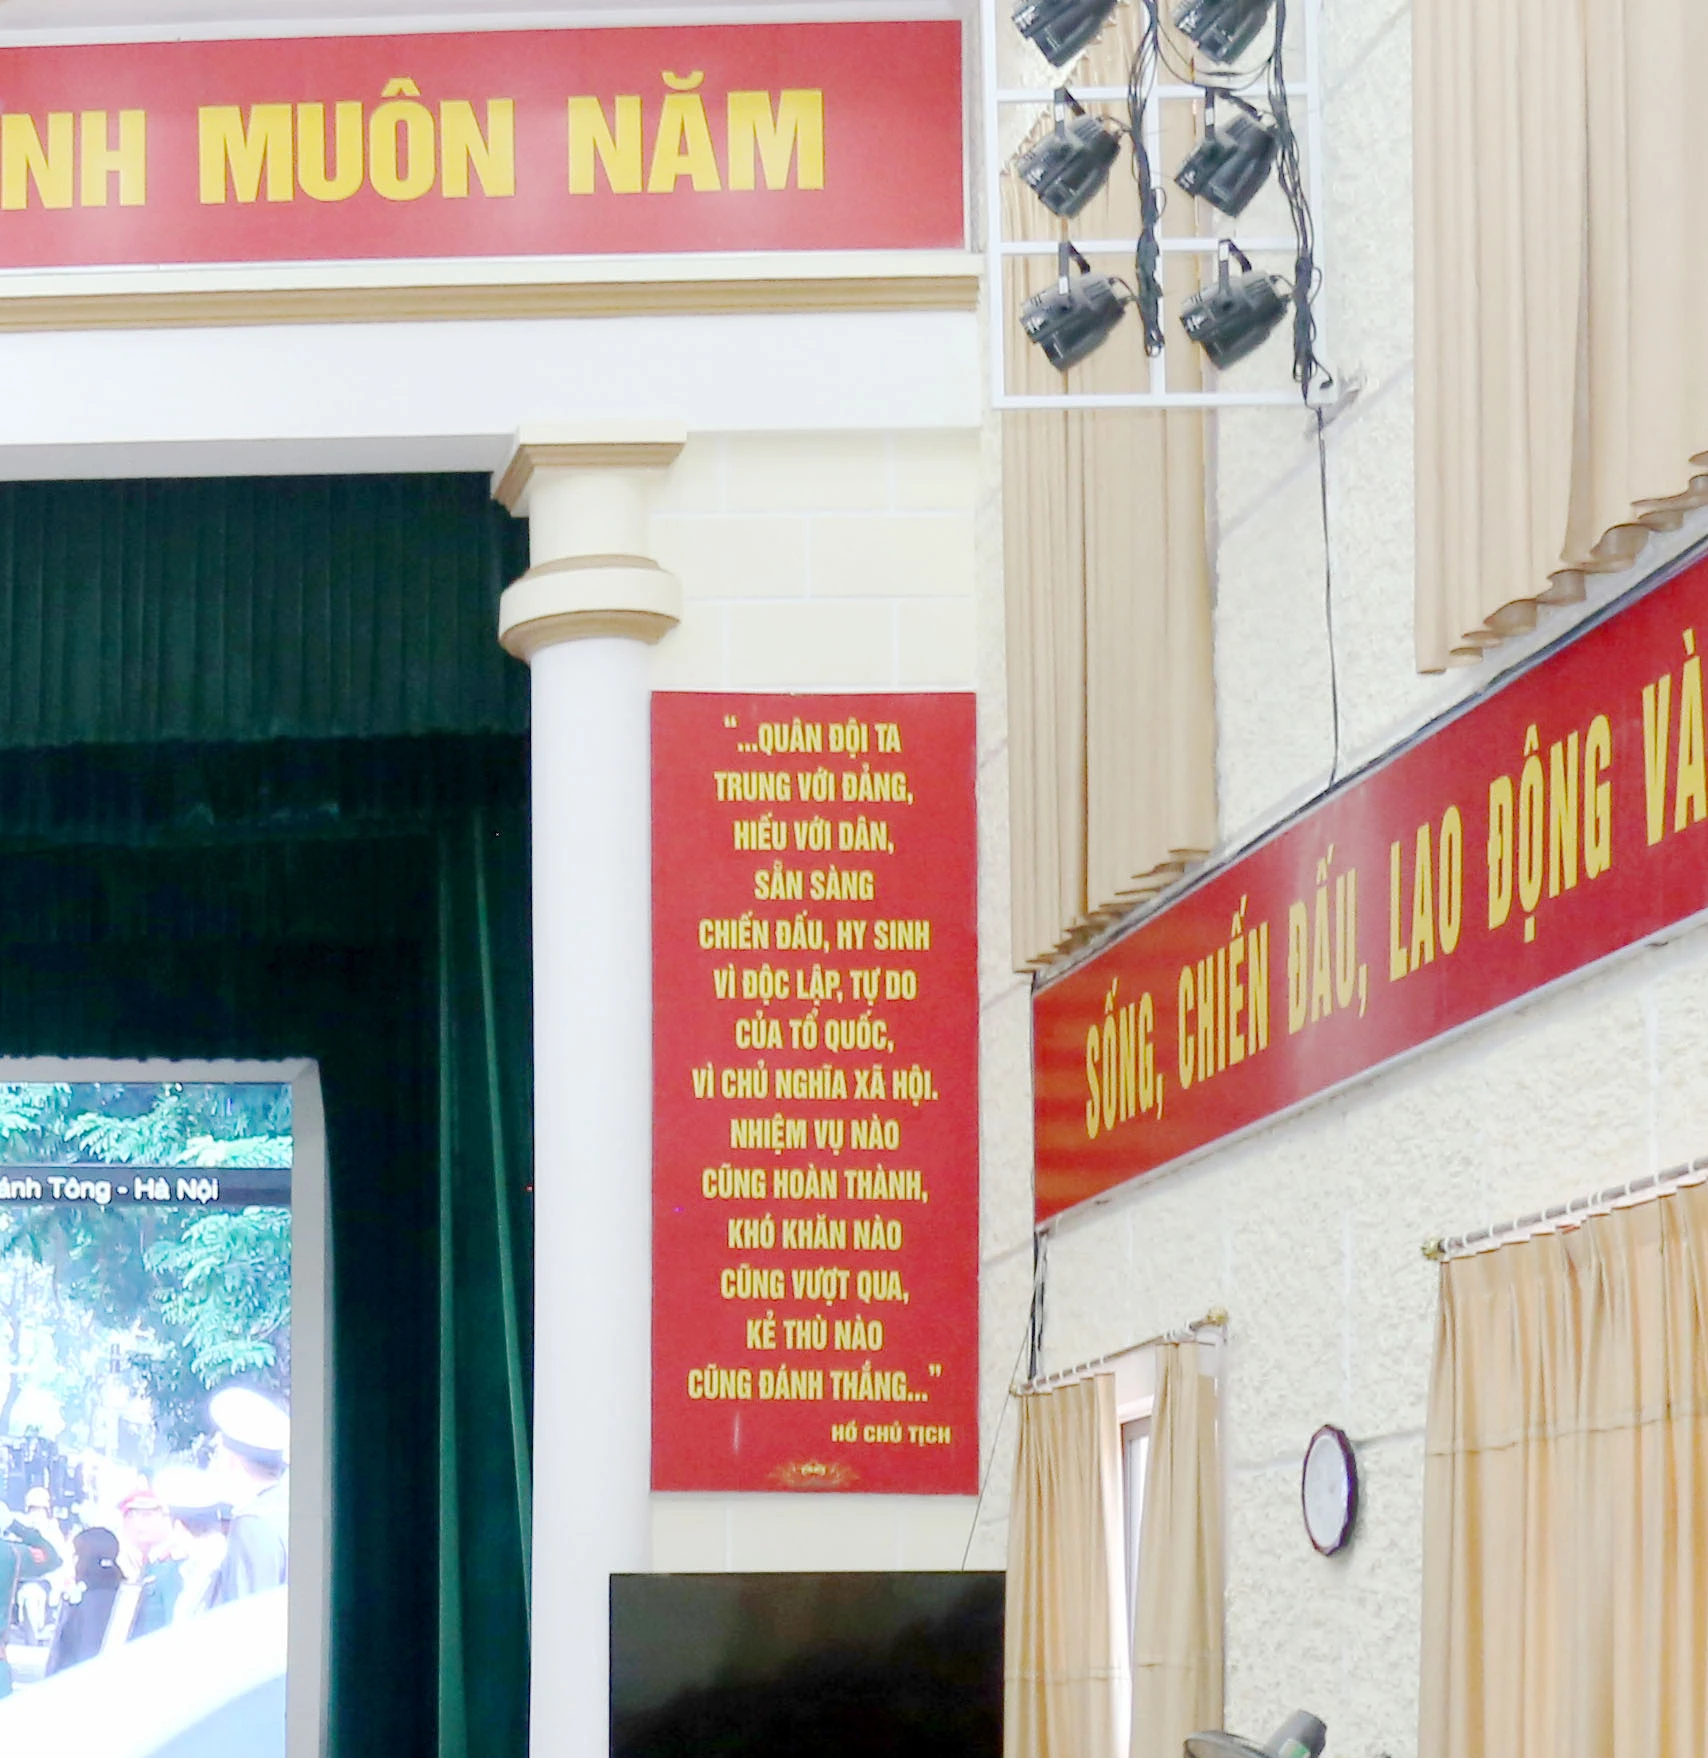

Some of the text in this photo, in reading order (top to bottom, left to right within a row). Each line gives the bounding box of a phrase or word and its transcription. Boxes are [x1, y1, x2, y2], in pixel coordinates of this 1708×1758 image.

[198, 78, 517, 204] MUÔN
[566, 71, 824, 194] NĂM
[829, 717, 868, 759] ĐỘI
[875, 723, 901, 752] TA
[714, 762, 913, 804] TRUNG VỚI ĐẢNG,
[734, 812, 894, 854] HIẾU VỚI DÂN,
[1087, 629, 1707, 1139] SỐNG, CHIẾN ĐẤU, LAO ĐỘNG VÀ
[699, 910, 929, 953] CHIẾN ĐẤU, HY SINH
[714, 963, 916, 1006] VÌ ĐỘC LẬP, TỰ DO
[692, 1059, 938, 1106] VÌ CHỦ NGHĨA XÃ HỘI.
[731, 1113, 899, 1155] NHIỆM VỤ NÀO
[48, 1179, 111, 1202] Tông
[134, 1178, 169, 1199] Hà
[177, 1179, 220, 1203] Nội
[702, 1163, 928, 1203] CŨNG HOÀN THÀNH,
[728, 1213, 901, 1250] KHÓ KHĂN NÀO
[721, 1263, 909, 1306] CŨNG VƯỢT QUA,
[747, 1310, 882, 1350] KẺ THÙ NÀO
[863, 1421, 902, 1443] CHỦ
[908, 1425, 951, 1446] TỊCH
